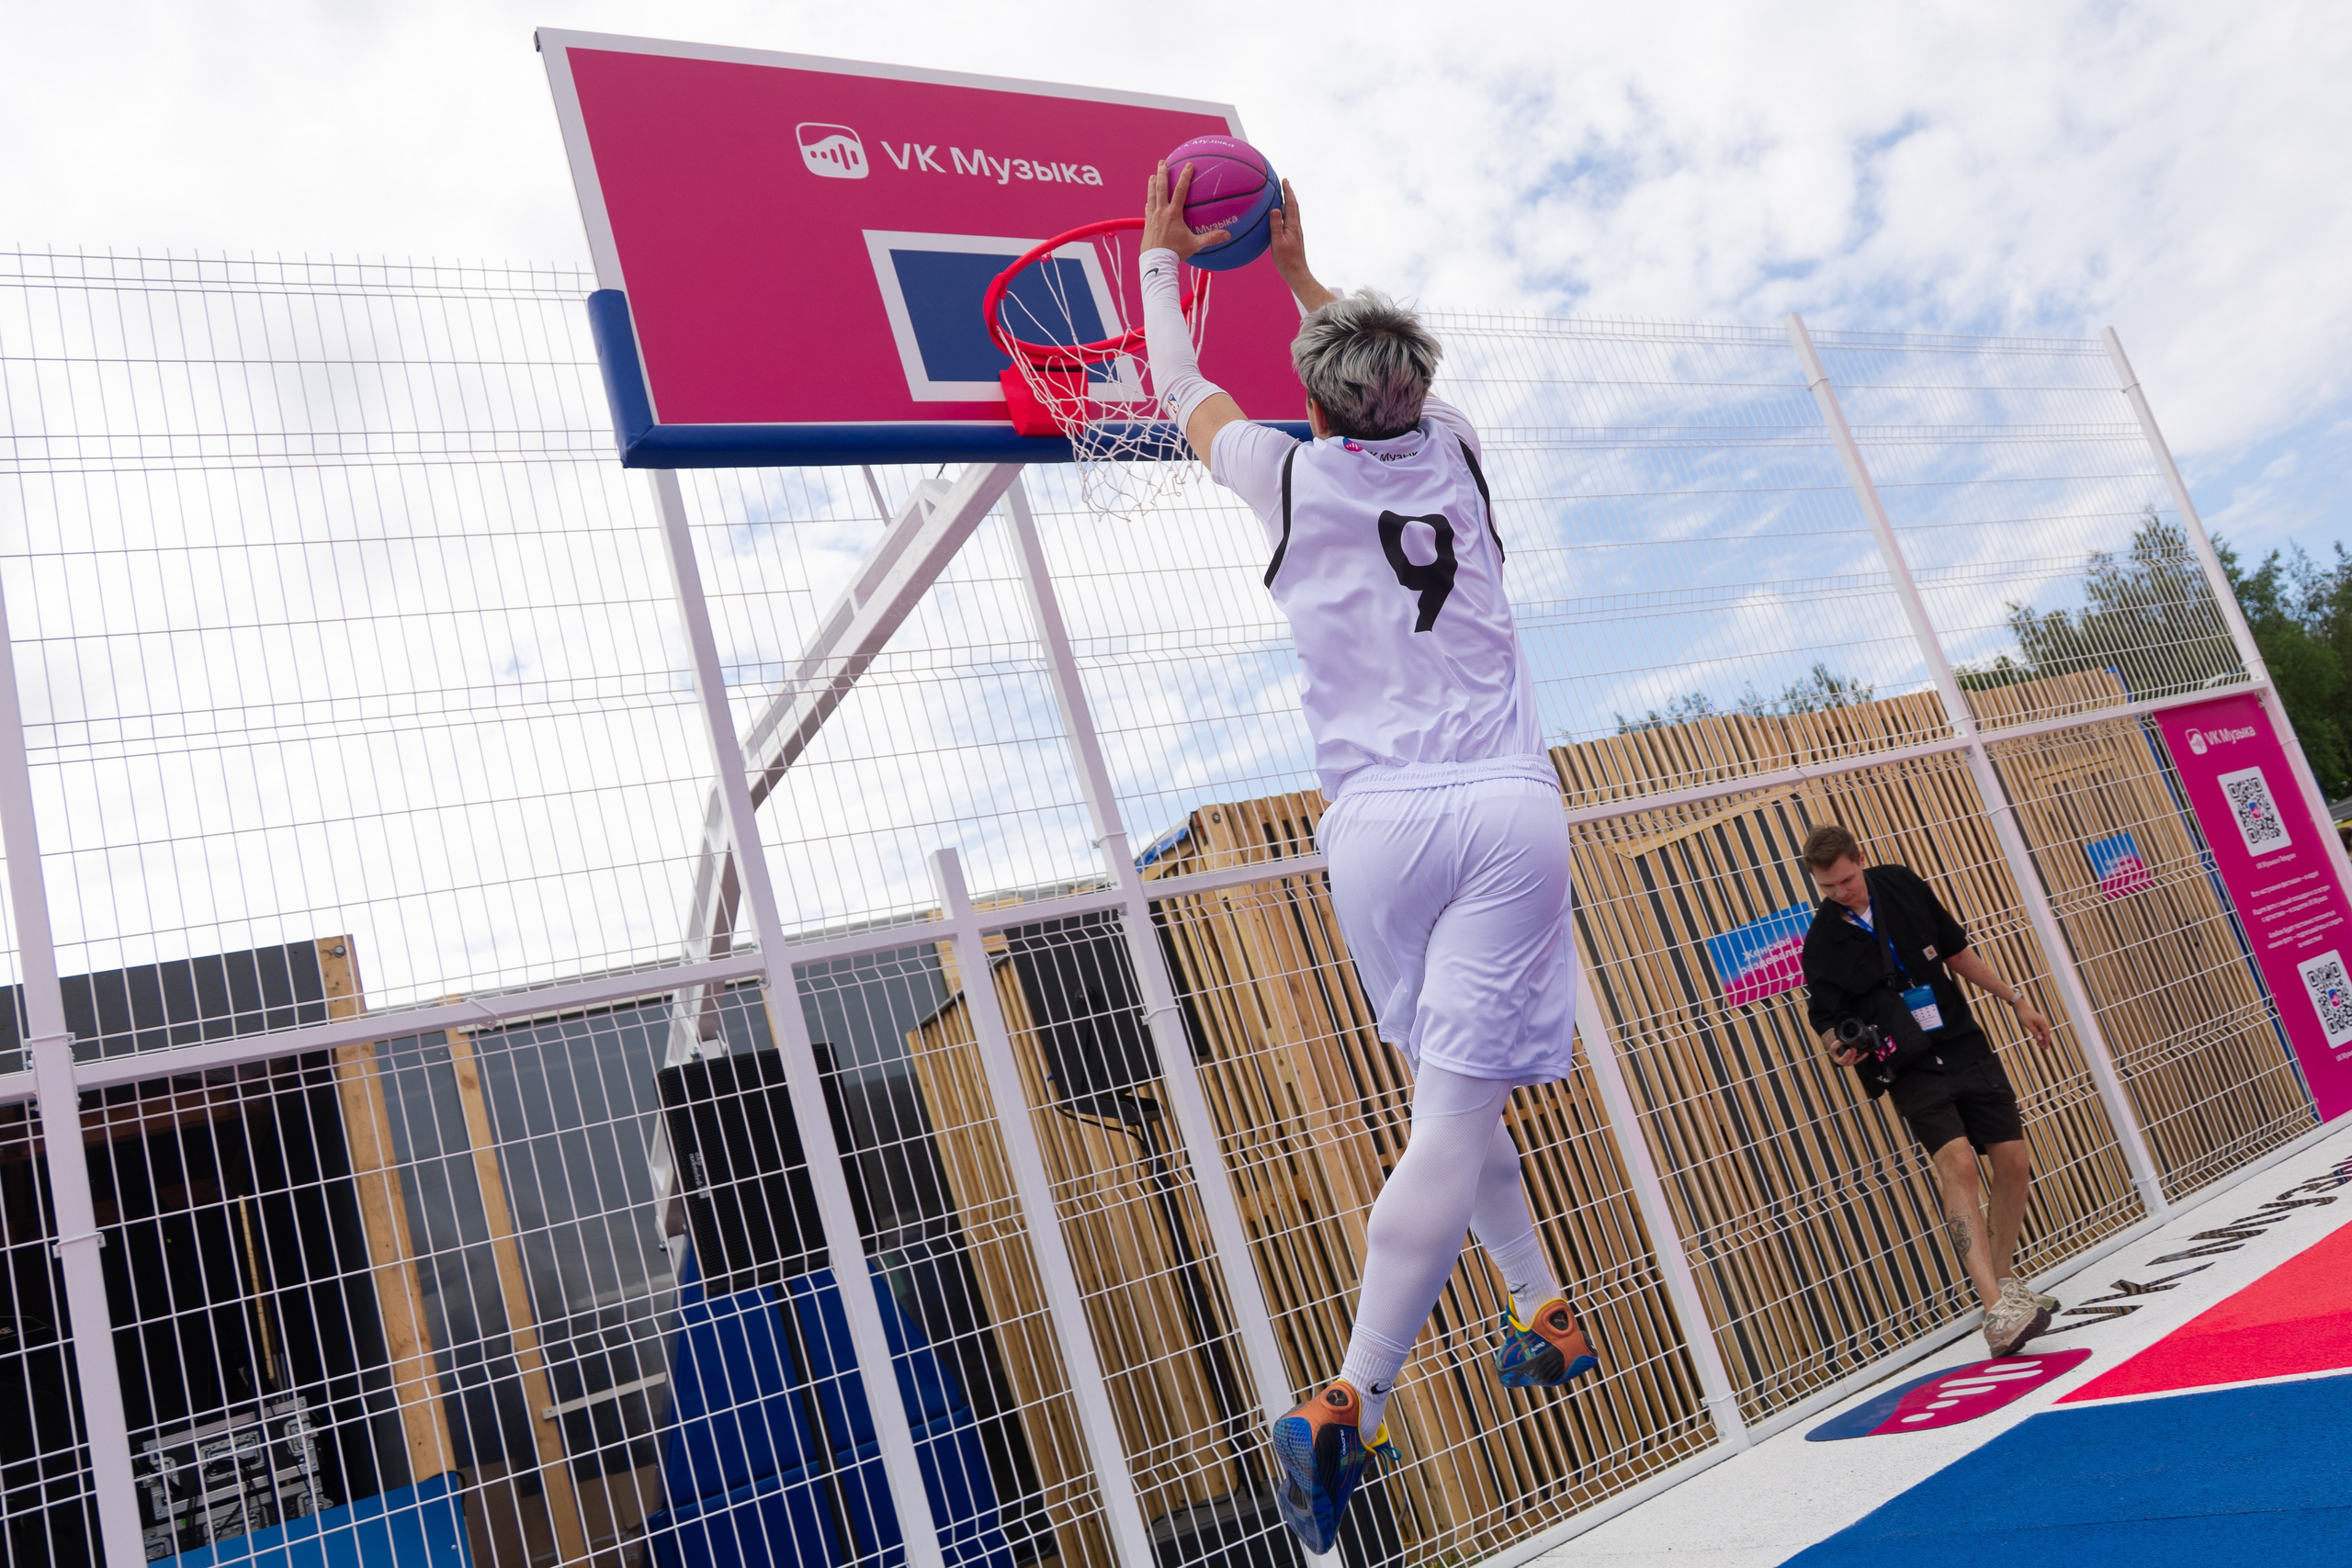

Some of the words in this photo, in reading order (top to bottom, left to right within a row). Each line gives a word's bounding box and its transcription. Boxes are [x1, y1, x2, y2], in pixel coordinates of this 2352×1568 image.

[880, 141, 947, 173] VK
[949, 146, 1103, 186] Музыка
[1195, 215, 1238, 235] Музыка
[1378, 510, 1458, 633] 9
[2203, 729, 2222, 746] VK
[2218, 726, 2257, 744] Музыка
[2026, 1261, 2216, 1337] VK
[2145, 1154, 2352, 1267] Муз
